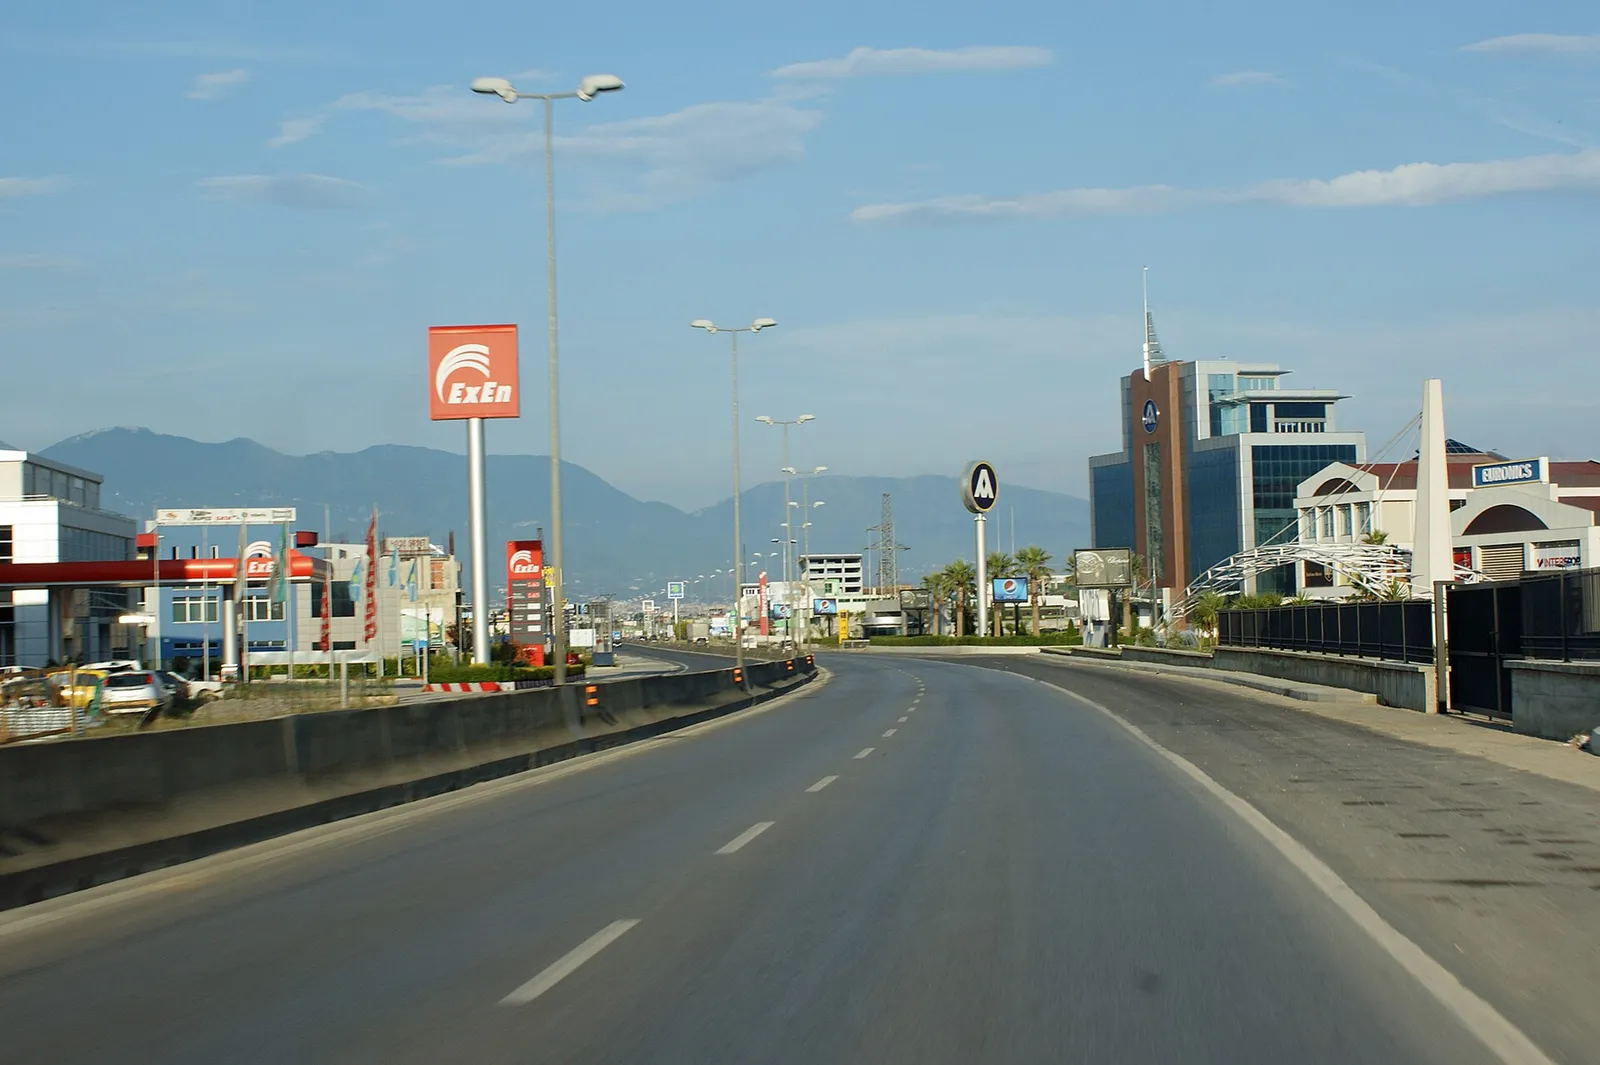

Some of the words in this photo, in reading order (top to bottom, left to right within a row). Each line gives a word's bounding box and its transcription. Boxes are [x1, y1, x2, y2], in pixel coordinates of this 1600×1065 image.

[447, 381, 512, 404] ExEn
[1482, 464, 1532, 482] EURONICS
[248, 561, 275, 573] ExE
[1544, 557, 1581, 567] INTERSPOR
